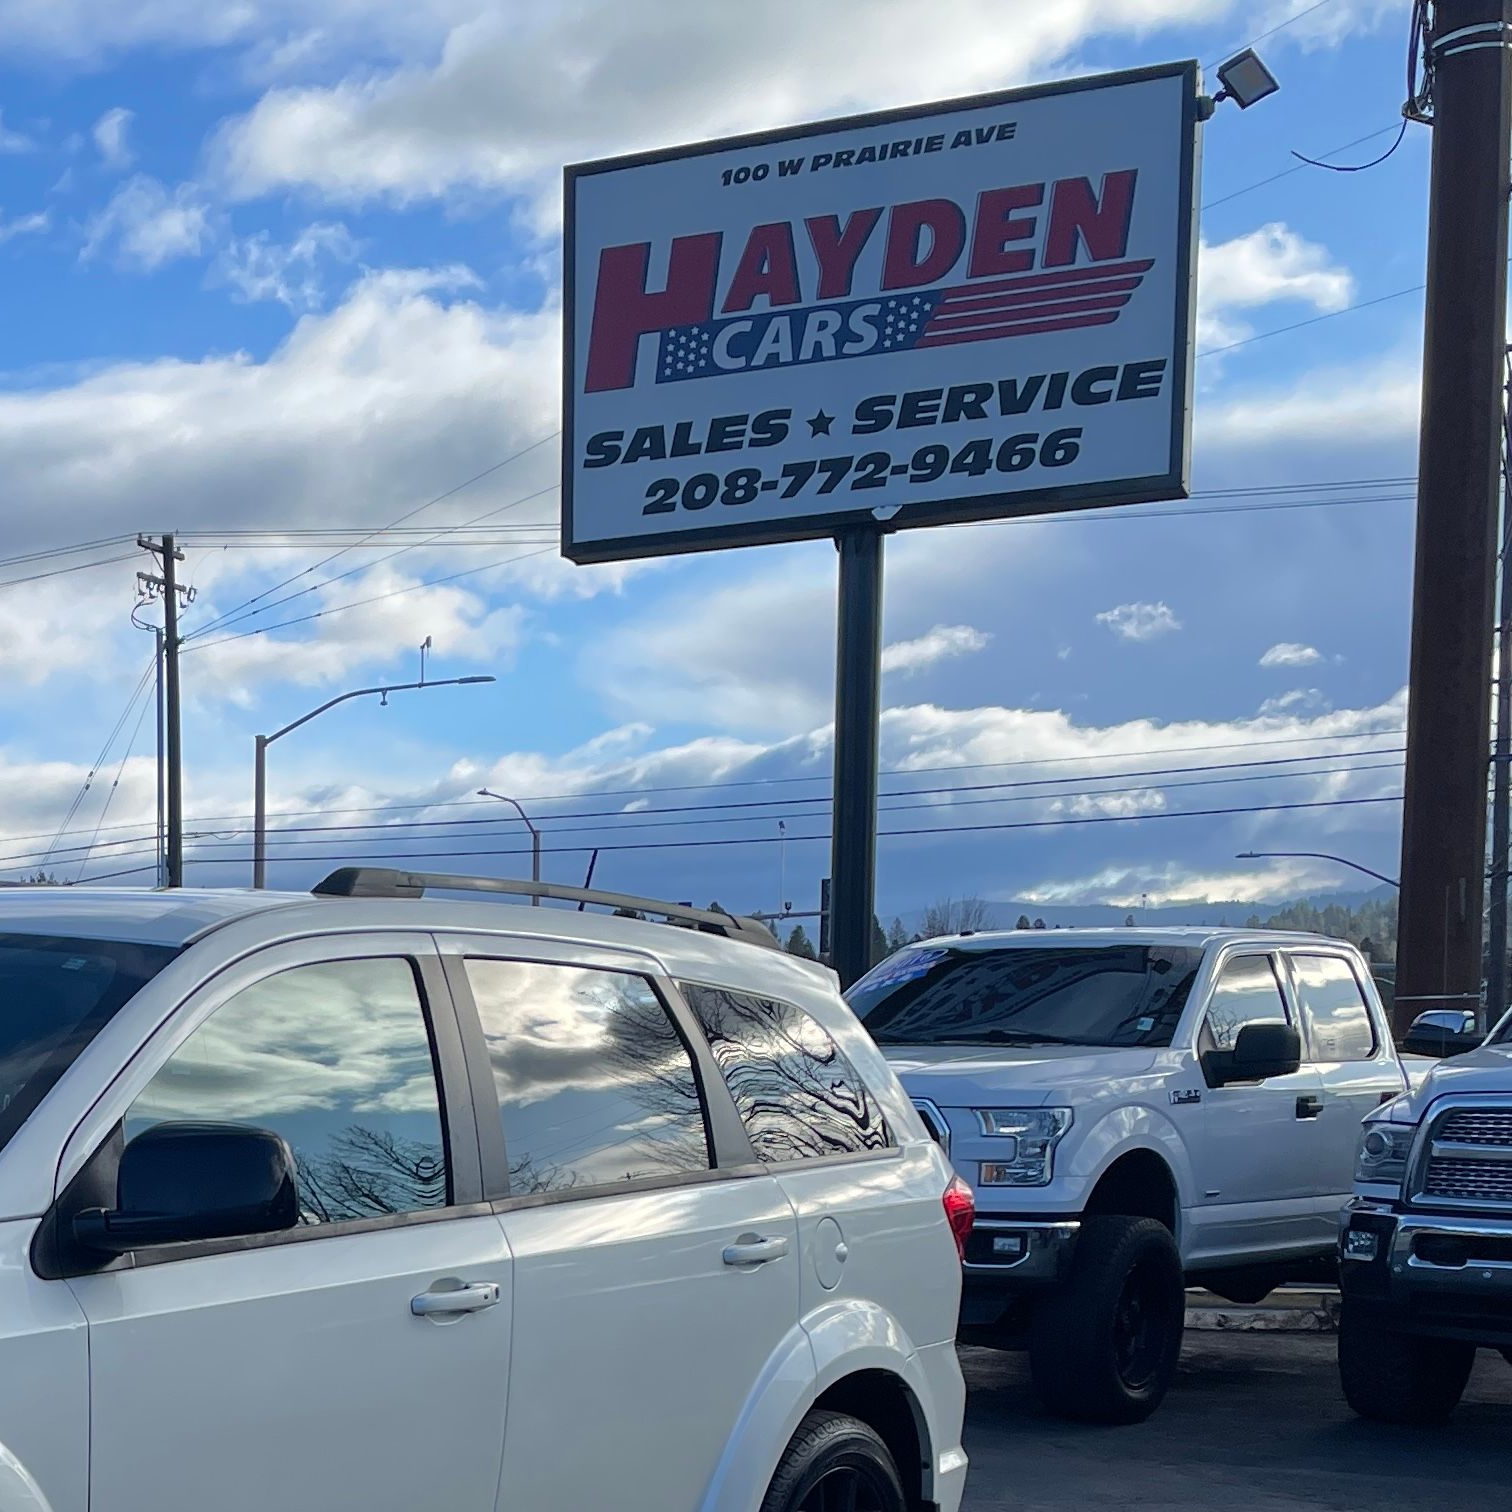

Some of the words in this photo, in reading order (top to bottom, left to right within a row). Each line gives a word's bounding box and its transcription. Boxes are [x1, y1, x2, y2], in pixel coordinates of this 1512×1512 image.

[721, 165, 769, 187] 100
[778, 156, 805, 177] W
[809, 133, 945, 174] PRAIRIE
[951, 122, 1018, 149] AVE
[584, 169, 1139, 393] HAYDEN
[712, 302, 883, 371] CARS
[583, 408, 792, 468] SALES
[851, 358, 1167, 436] SERVICE
[642, 428, 1083, 516] 208-772-9466
